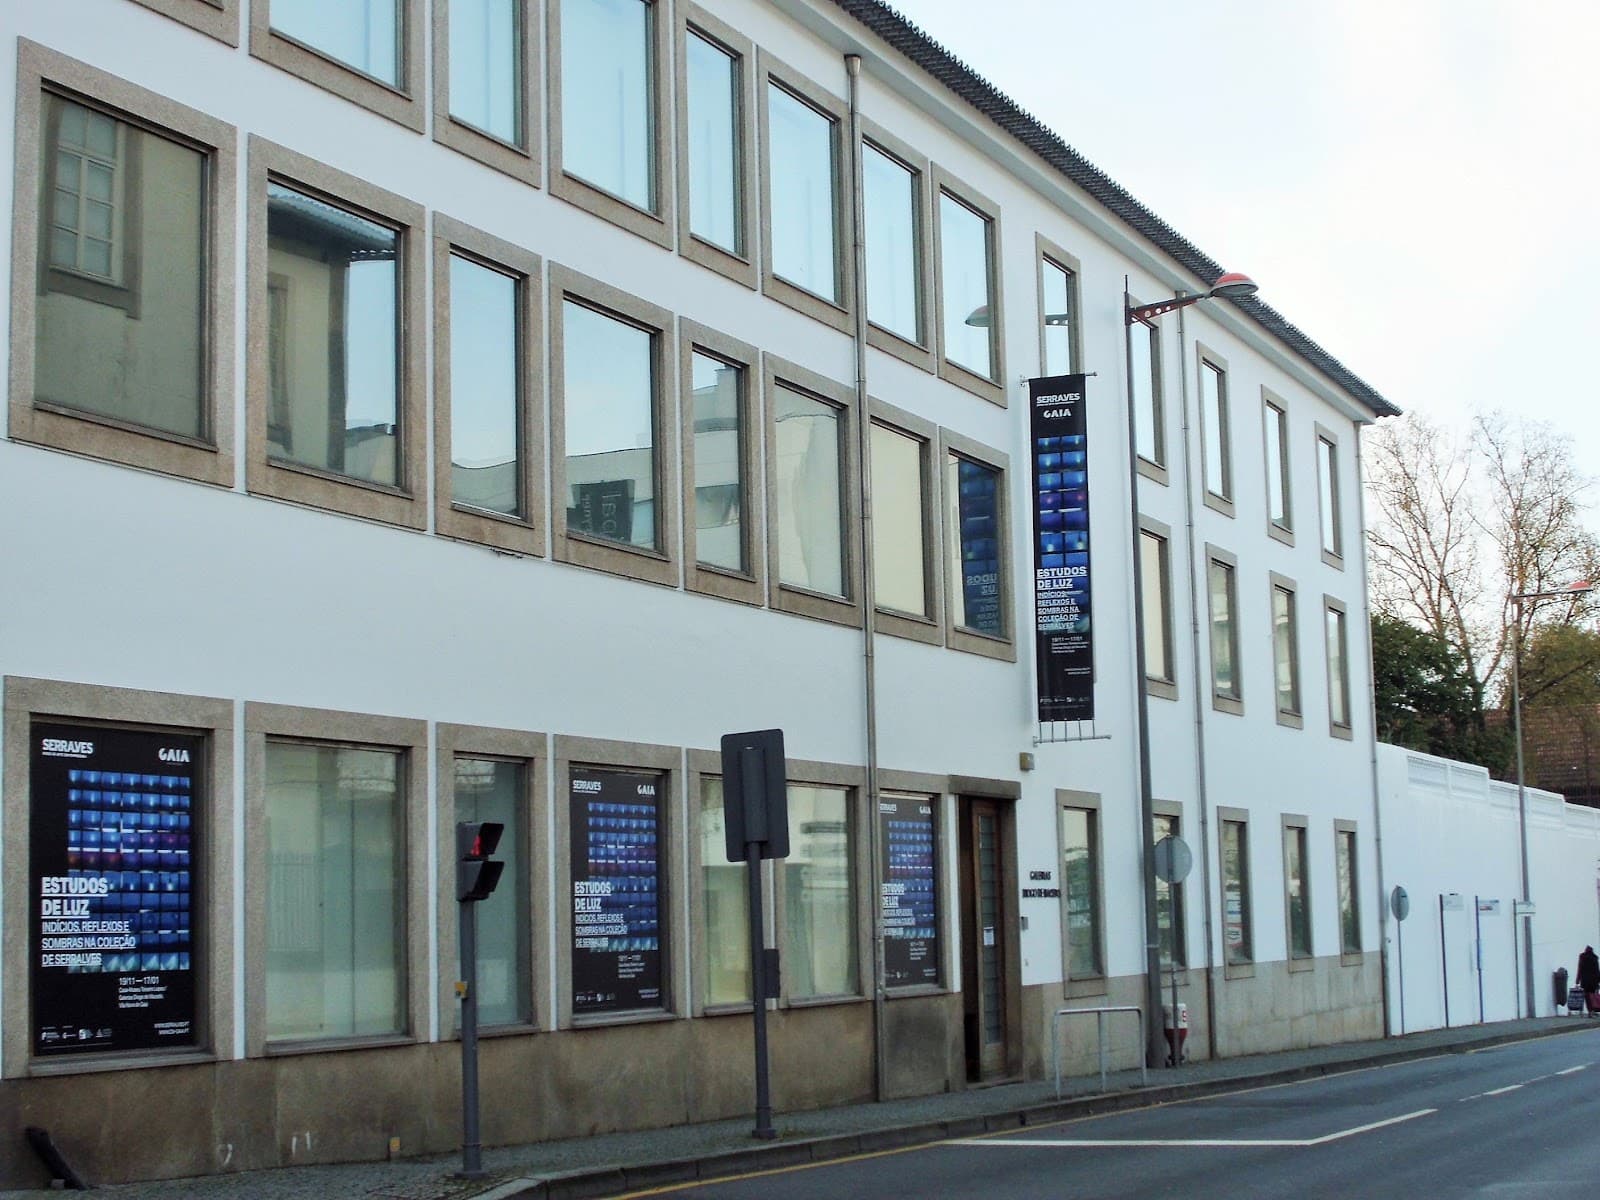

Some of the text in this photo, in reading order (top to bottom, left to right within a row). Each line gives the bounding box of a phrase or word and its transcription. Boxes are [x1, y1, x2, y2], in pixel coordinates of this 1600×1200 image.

[1043, 409, 1071, 418] GAIA
[1037, 566, 1087, 578] ESTUDOS
[1037, 578, 1073, 588] DE LUZ
[1038, 606, 1069, 614] SOMBRAS
[158, 748, 190, 763] GAIA
[637, 785, 655, 795] GAIA
[42, 877, 108, 894] ESTUDOS
[575, 882, 611, 894] ESTUDOS
[42, 899, 90, 916] DE LUZ
[575, 897, 601, 909] DE LUZ
[82, 921, 123, 931] REFLEXOS
[124, 921, 129, 931] E
[42, 934, 136, 950] SOMBRAS NA COLEÇÃO
[42, 953, 102, 964] DE SERRALVES
